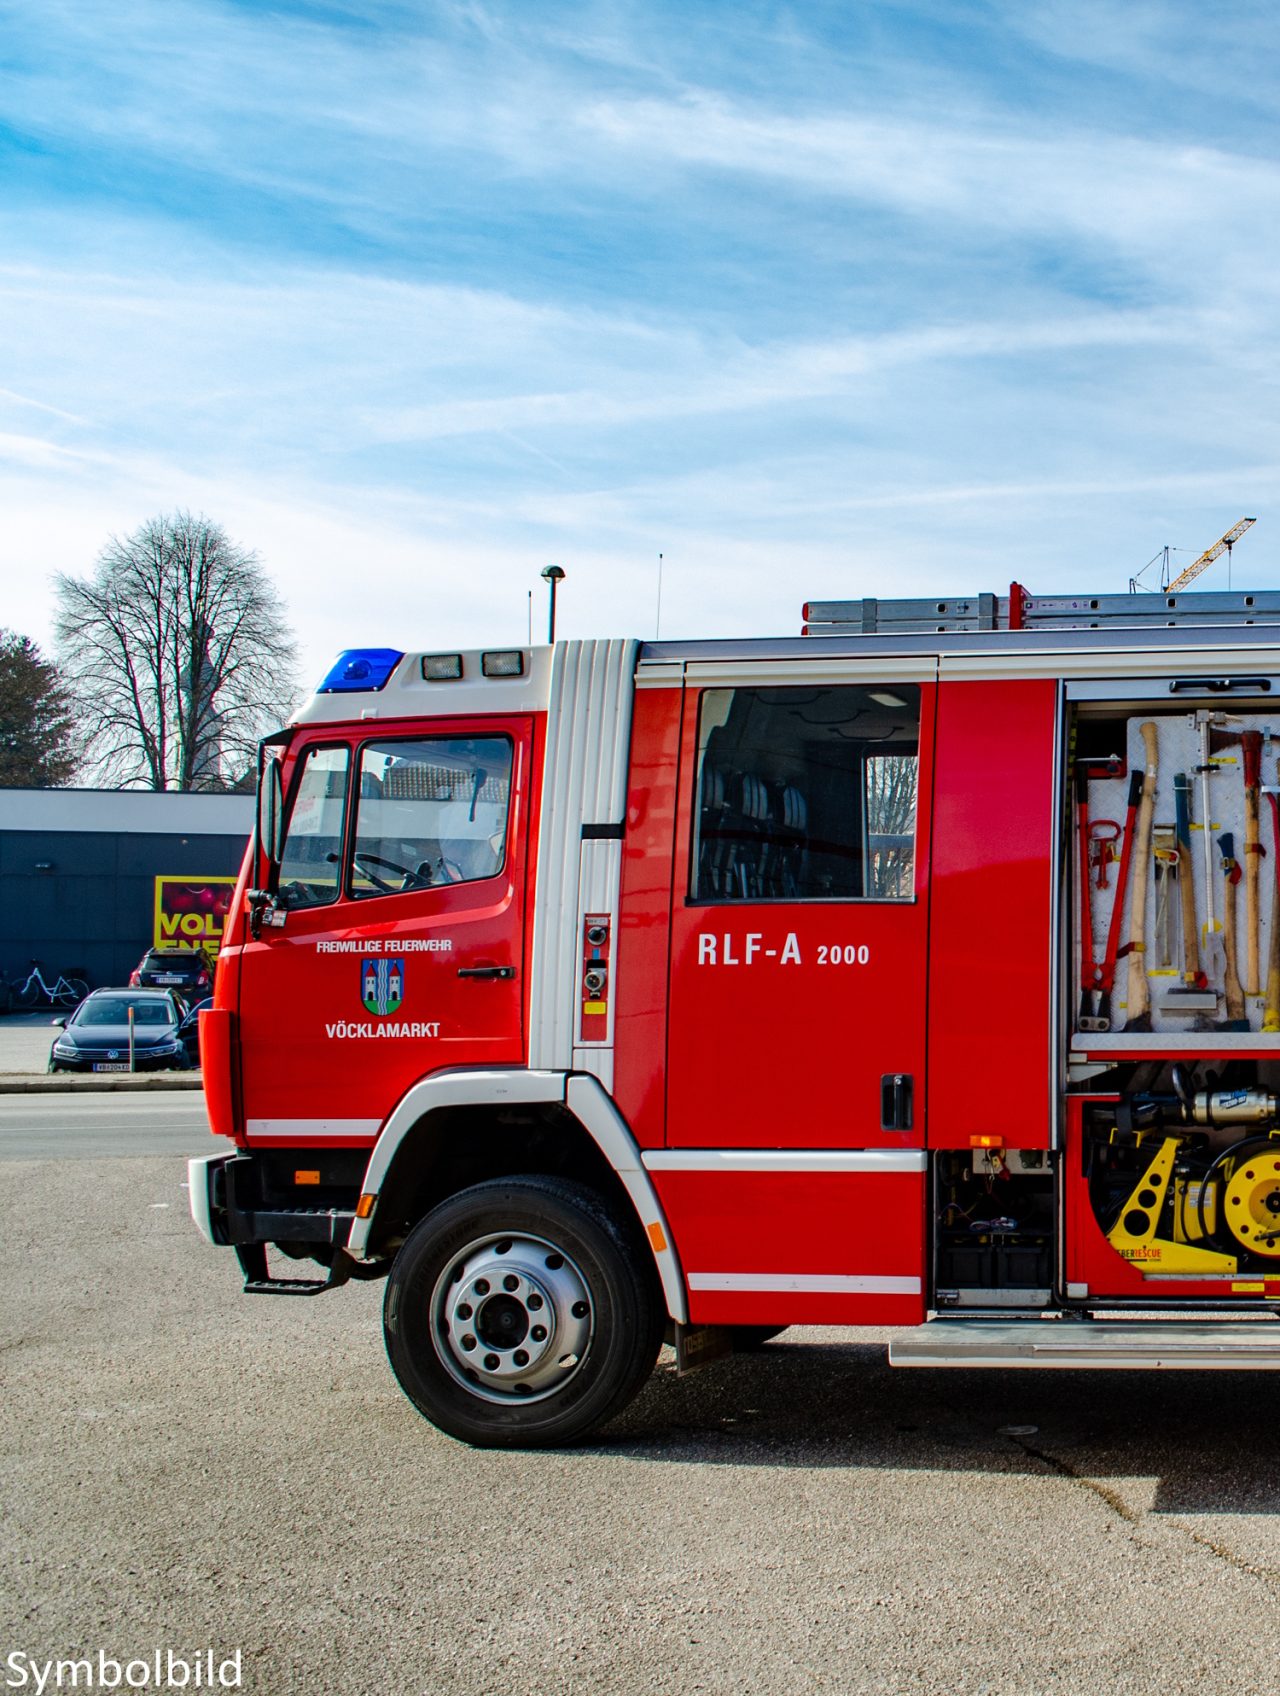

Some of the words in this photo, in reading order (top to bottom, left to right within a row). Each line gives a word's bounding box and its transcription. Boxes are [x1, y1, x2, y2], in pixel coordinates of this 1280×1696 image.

[316, 940, 382, 953] FREIWILLIGE
[384, 939, 452, 952] FEUERWEHR
[698, 932, 802, 965] RLF-A
[817, 945, 869, 965] 2000
[325, 1020, 440, 1038] VÖCKLAMARKT
